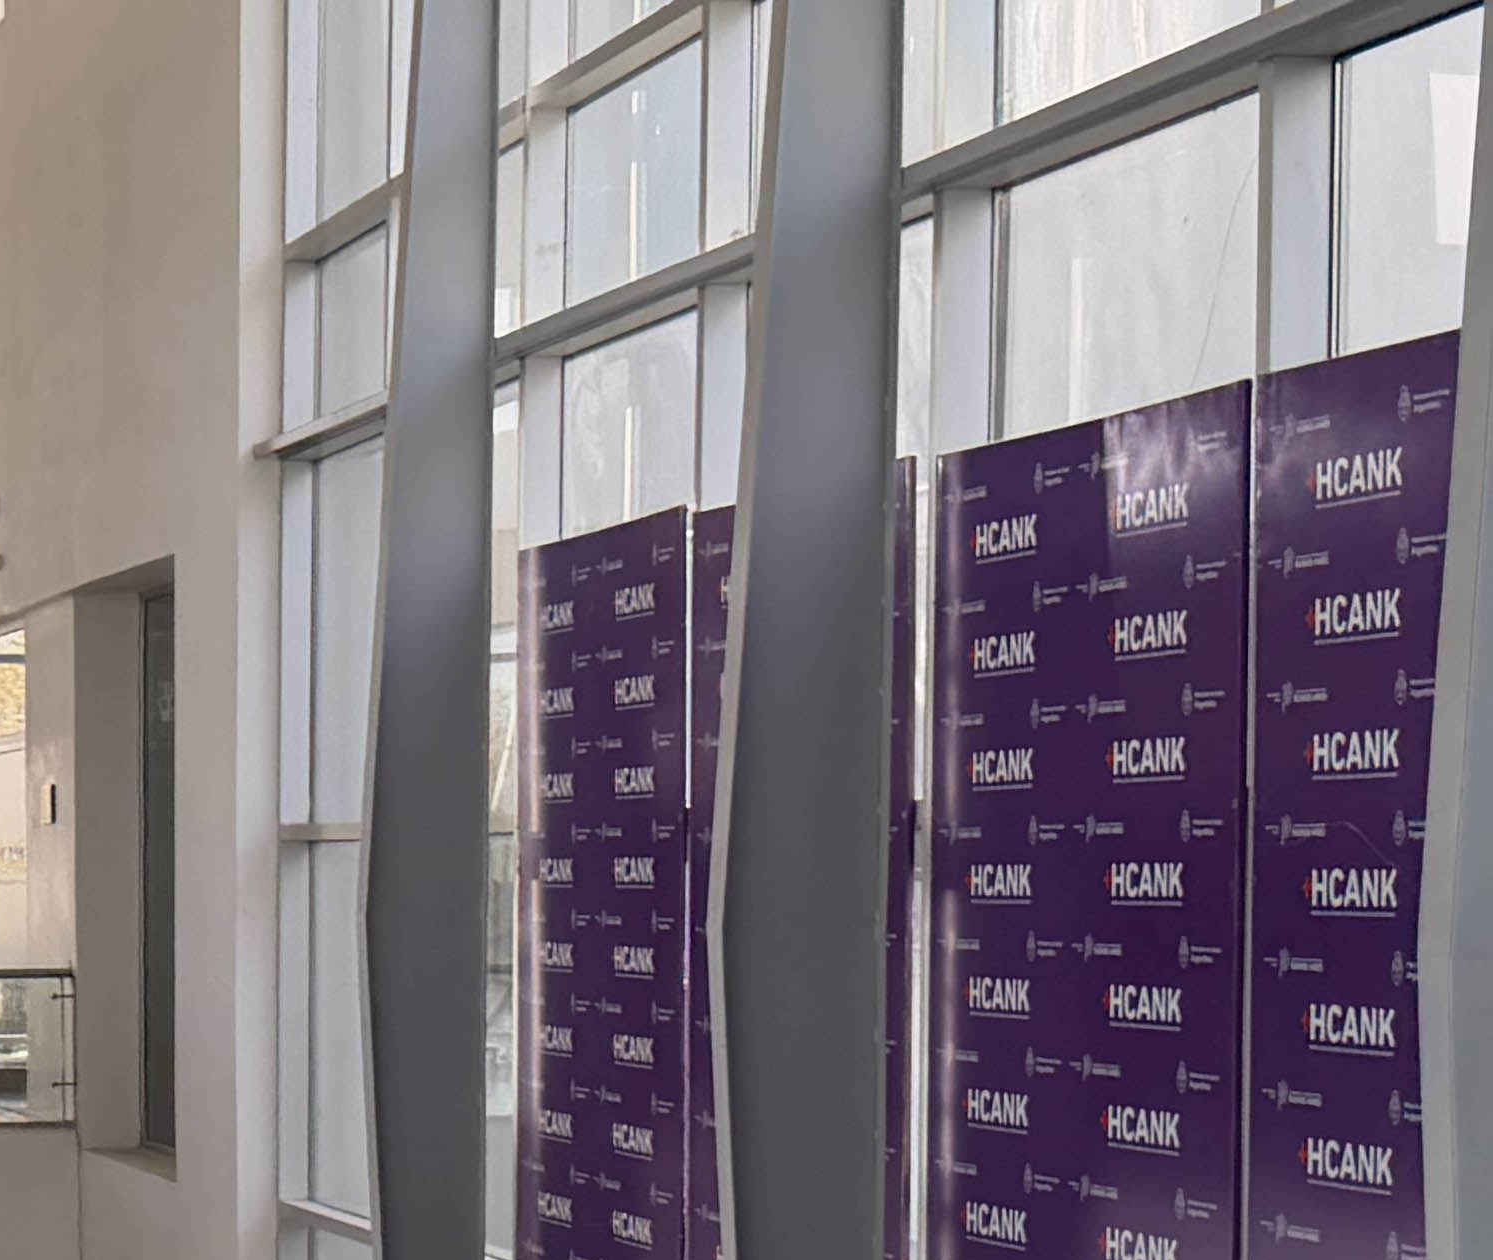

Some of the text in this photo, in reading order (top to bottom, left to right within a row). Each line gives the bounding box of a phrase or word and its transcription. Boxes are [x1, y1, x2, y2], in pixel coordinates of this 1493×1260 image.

[1316, 446, 1403, 500] HCANK
[1116, 483, 1189, 529] HCANK
[975, 513, 1037, 557] HCANK
[614, 583, 655, 615] HCANK
[1314, 588, 1401, 636] HCANK
[973, 630, 1035, 670] HCANK
[1114, 609, 1187, 653] HCANK
[614, 675, 655, 705] HCANK
[972, 748, 1034, 784] HCANK
[1112, 736, 1185, 775] HCANK
[1313, 728, 1399, 772] HCANK
[614, 766, 655, 793] HCANK
[614, 856, 655, 883] HCANK
[970, 864, 1031, 897] HCANK
[1111, 862, 1184, 898] HCANK
[1311, 868, 1398, 908] HCANK
[613, 945, 655, 973] HCANK
[969, 976, 1030, 1012] HCANK
[1109, 984, 1182, 1023] HCANK
[1309, 1003, 1395, 1048] HCANK
[613, 1034, 654, 1063] HCANK
[538, 1109, 574, 1136] HCANK
[967, 1088, 1028, 1127] HCANK
[1107, 1105, 1180, 1148] HCANK
[612, 1123, 653, 1154] HCANK
[1307, 1137, 1393, 1186] HCANK
[538, 1191, 574, 1220] HCANK
[966, 1201, 1027, 1244] HCANK
[612, 1210, 653, 1245] HCANK
